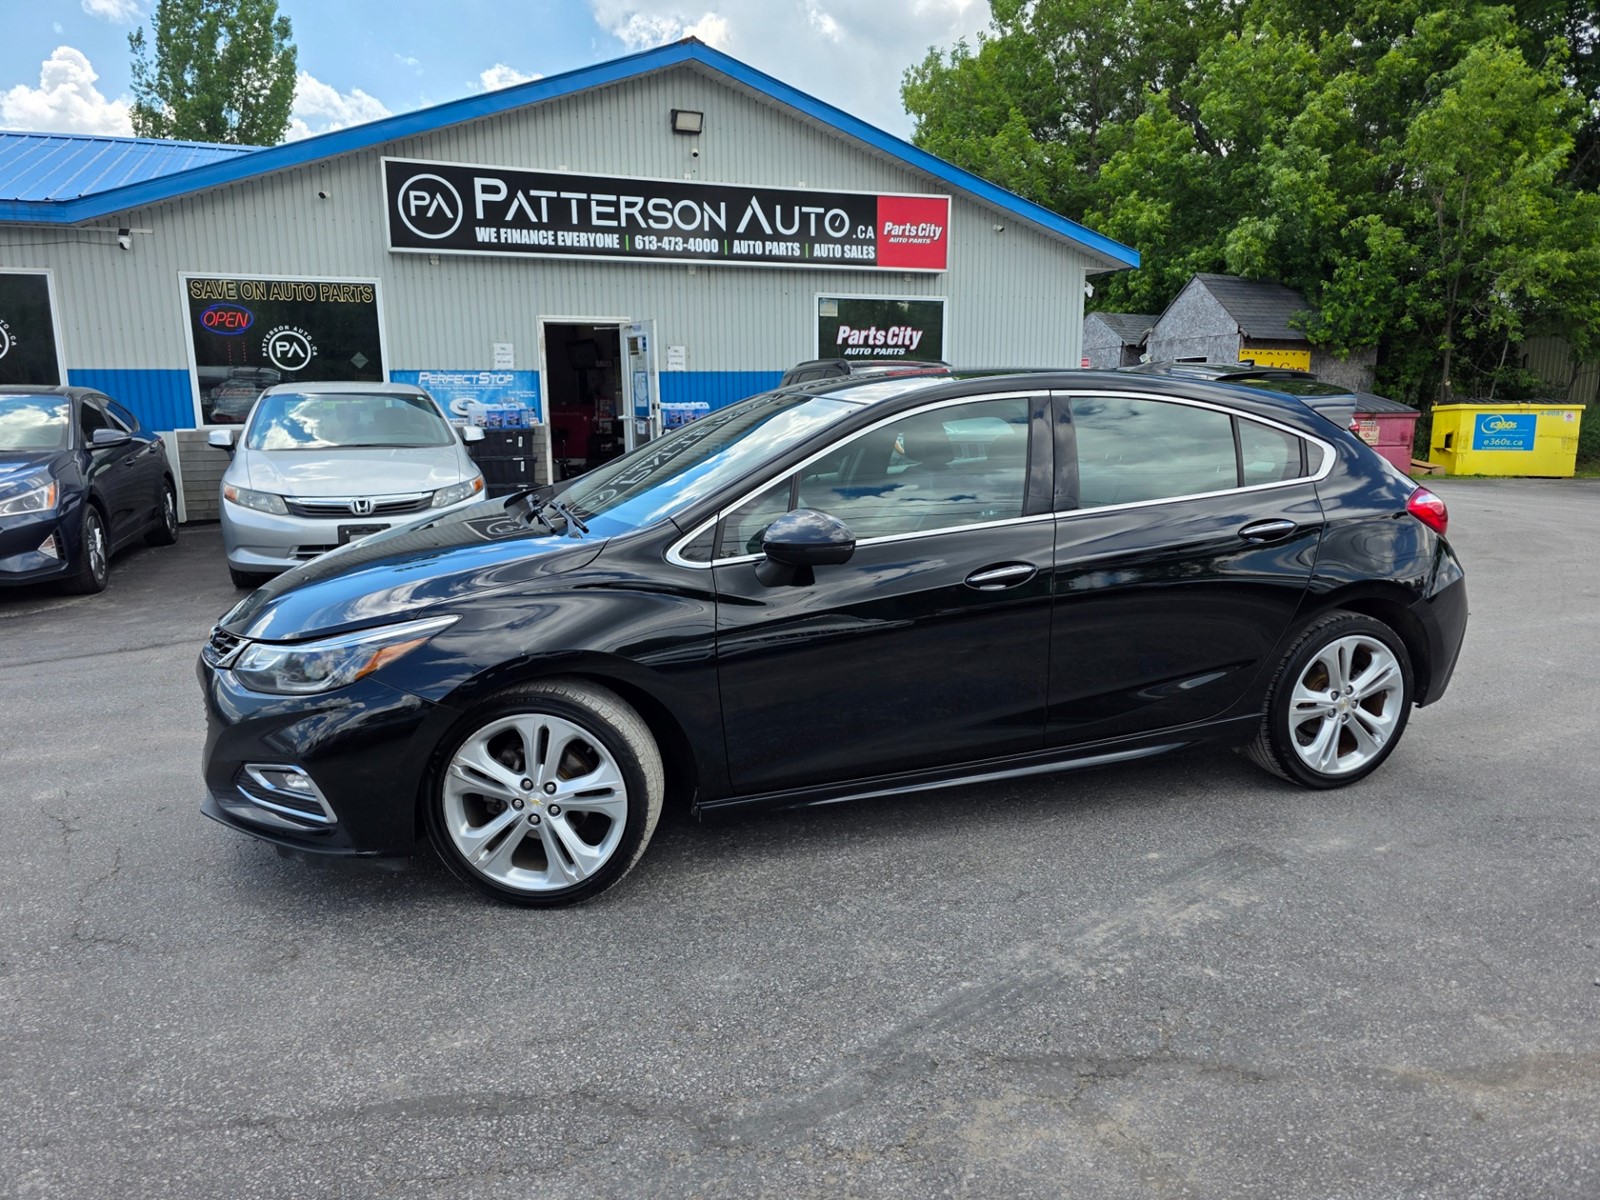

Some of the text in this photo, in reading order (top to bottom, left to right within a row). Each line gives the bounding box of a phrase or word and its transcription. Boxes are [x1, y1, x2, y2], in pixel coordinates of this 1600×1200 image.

[474, 177, 726, 232] PATTERSON
[475, 227, 875, 260] WE FINANCE EVERYONE 613-473-4000 AUTO PARTS AUTO SALES
[190, 280, 374, 303] SAVE ON AUTO PARTS
[203, 311, 249, 328] OPEN
[261, 324, 290, 357] PATTERSON
[844, 347, 906, 355] AUTO PARTS
